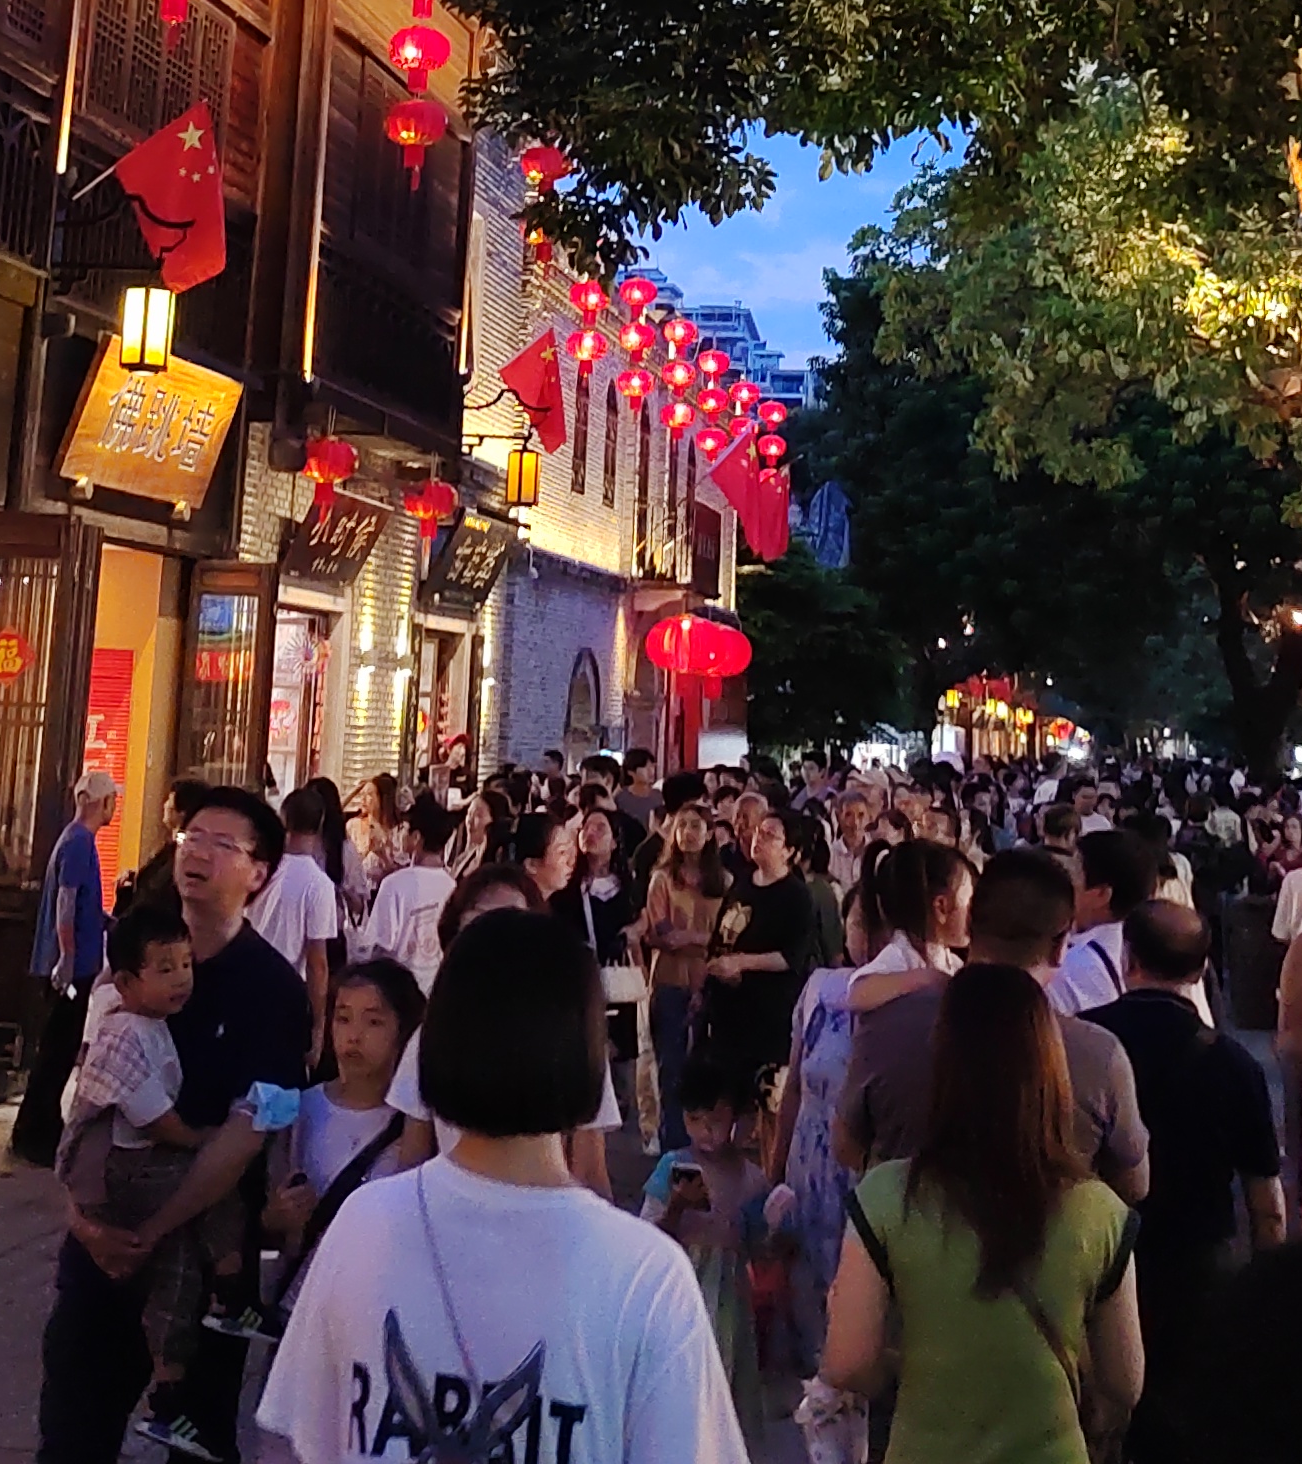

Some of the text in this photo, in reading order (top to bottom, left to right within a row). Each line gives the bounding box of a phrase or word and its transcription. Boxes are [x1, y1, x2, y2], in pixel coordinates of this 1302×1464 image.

[98, 376, 216, 473] 佛跳墙
[349, 1362, 588, 1464] RABIT
